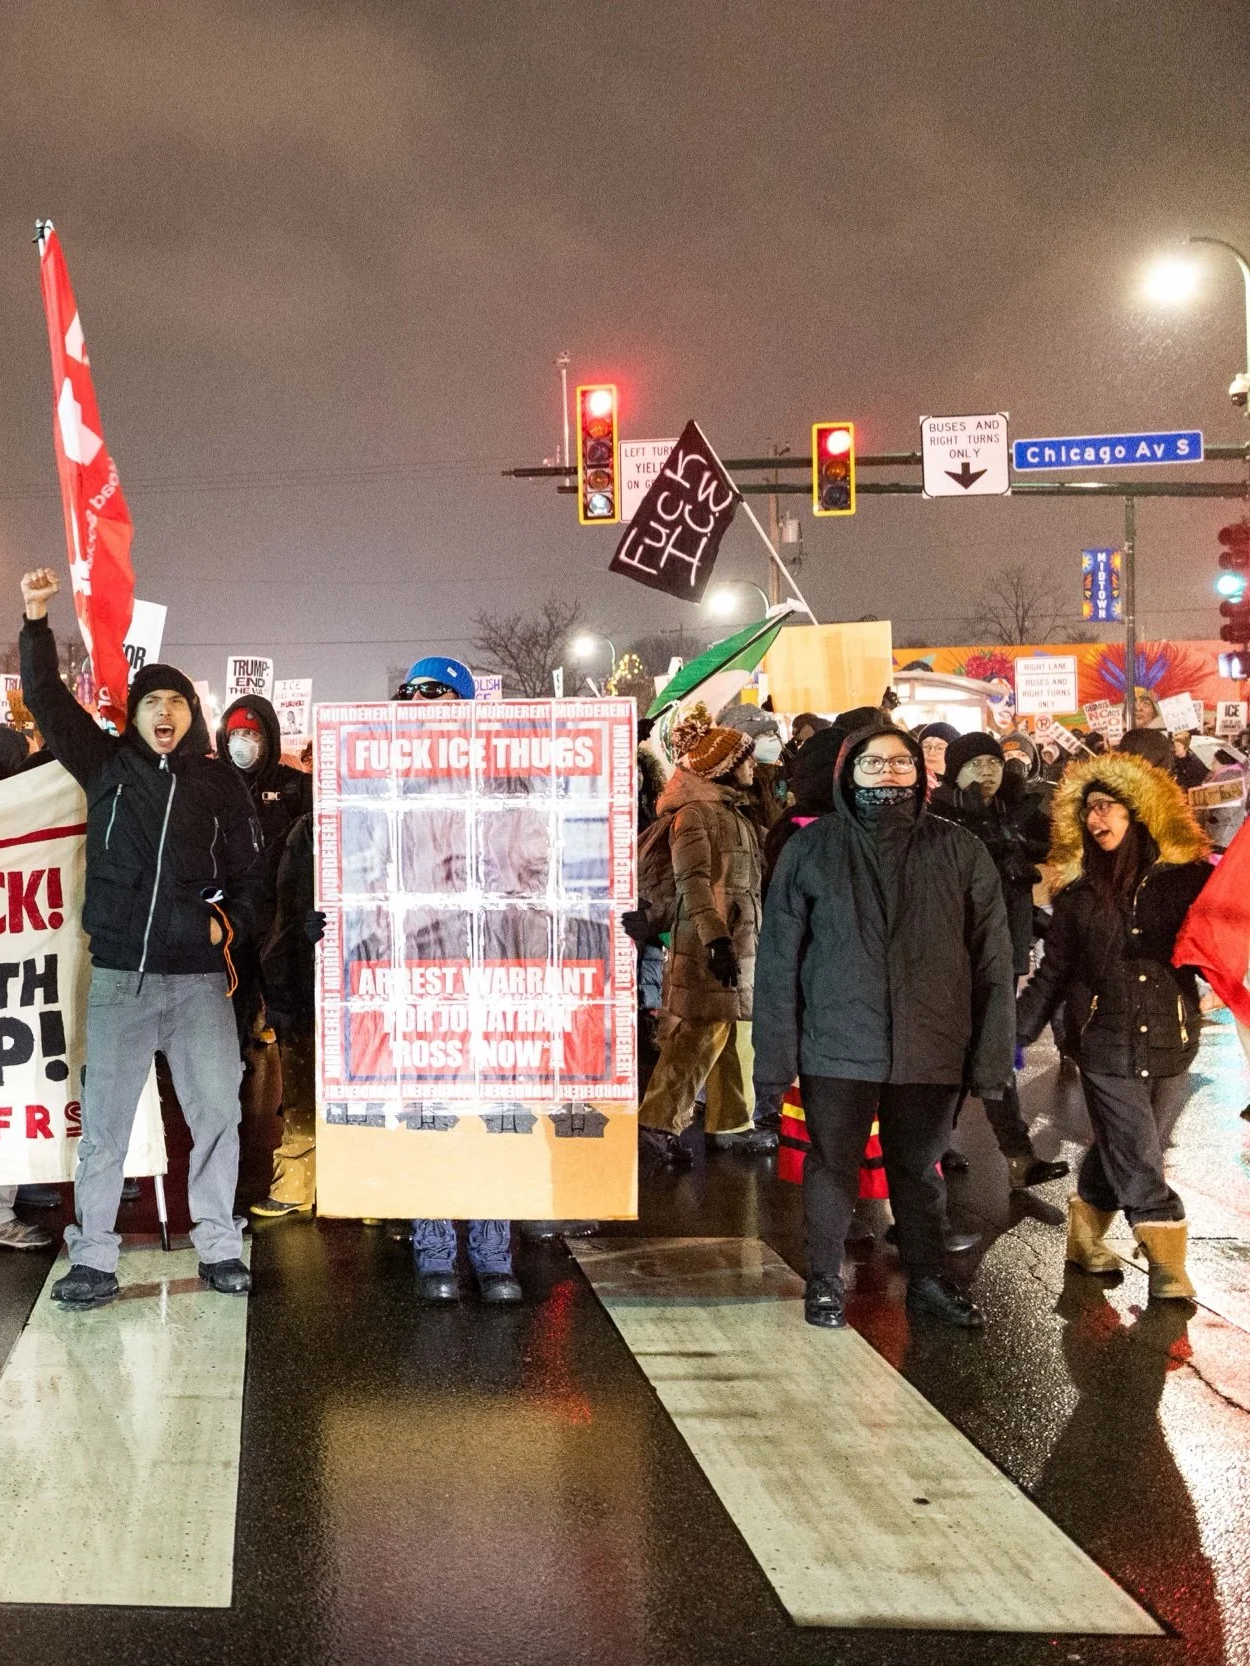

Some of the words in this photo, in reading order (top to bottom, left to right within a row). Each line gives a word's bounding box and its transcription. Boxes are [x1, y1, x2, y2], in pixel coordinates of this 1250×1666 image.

[929, 421, 966, 433] BUSES
[976, 420, 1000, 431] AND
[930, 435, 959, 446] RIGHT
[968, 434, 1000, 445] TURNS
[624, 447, 646, 458] LEFT
[949, 448, 981, 460] ONLY
[1026, 446, 1126, 464] Chicago
[1135, 441, 1165, 458] Av
[1176, 438, 1190, 455] S
[627, 480, 640, 490] ON
[1097, 552, 1108, 618] MIDTOWN
[122, 644, 146, 669] OR
[233, 659, 270, 677] TRUMP:
[1024, 663, 1045, 671] RIGHT
[1048, 662, 1067, 670] LANE
[235, 677, 266, 687] END
[1025, 679, 1050, 687] BUSES
[1052, 678, 1068, 686] AND
[228, 687, 251, 695] THE
[1022, 690, 1044, 698] RIGHT
[1047, 689, 1071, 697] TURNS
[1038, 701, 1055, 709] ONLY
[1224, 704, 1240, 717] ICE
[397, 705, 470, 720] MURDERER!
[476, 704, 549, 719] MURDERER!
[555, 703, 630, 718] MURDERER!
[355, 738, 433, 771] FUCK
[438, 737, 486, 770] ICE
[492, 736, 594, 769] THUGS
[461, 966, 596, 994] WARRANT
[392, 1040, 462, 1068] ROSS
